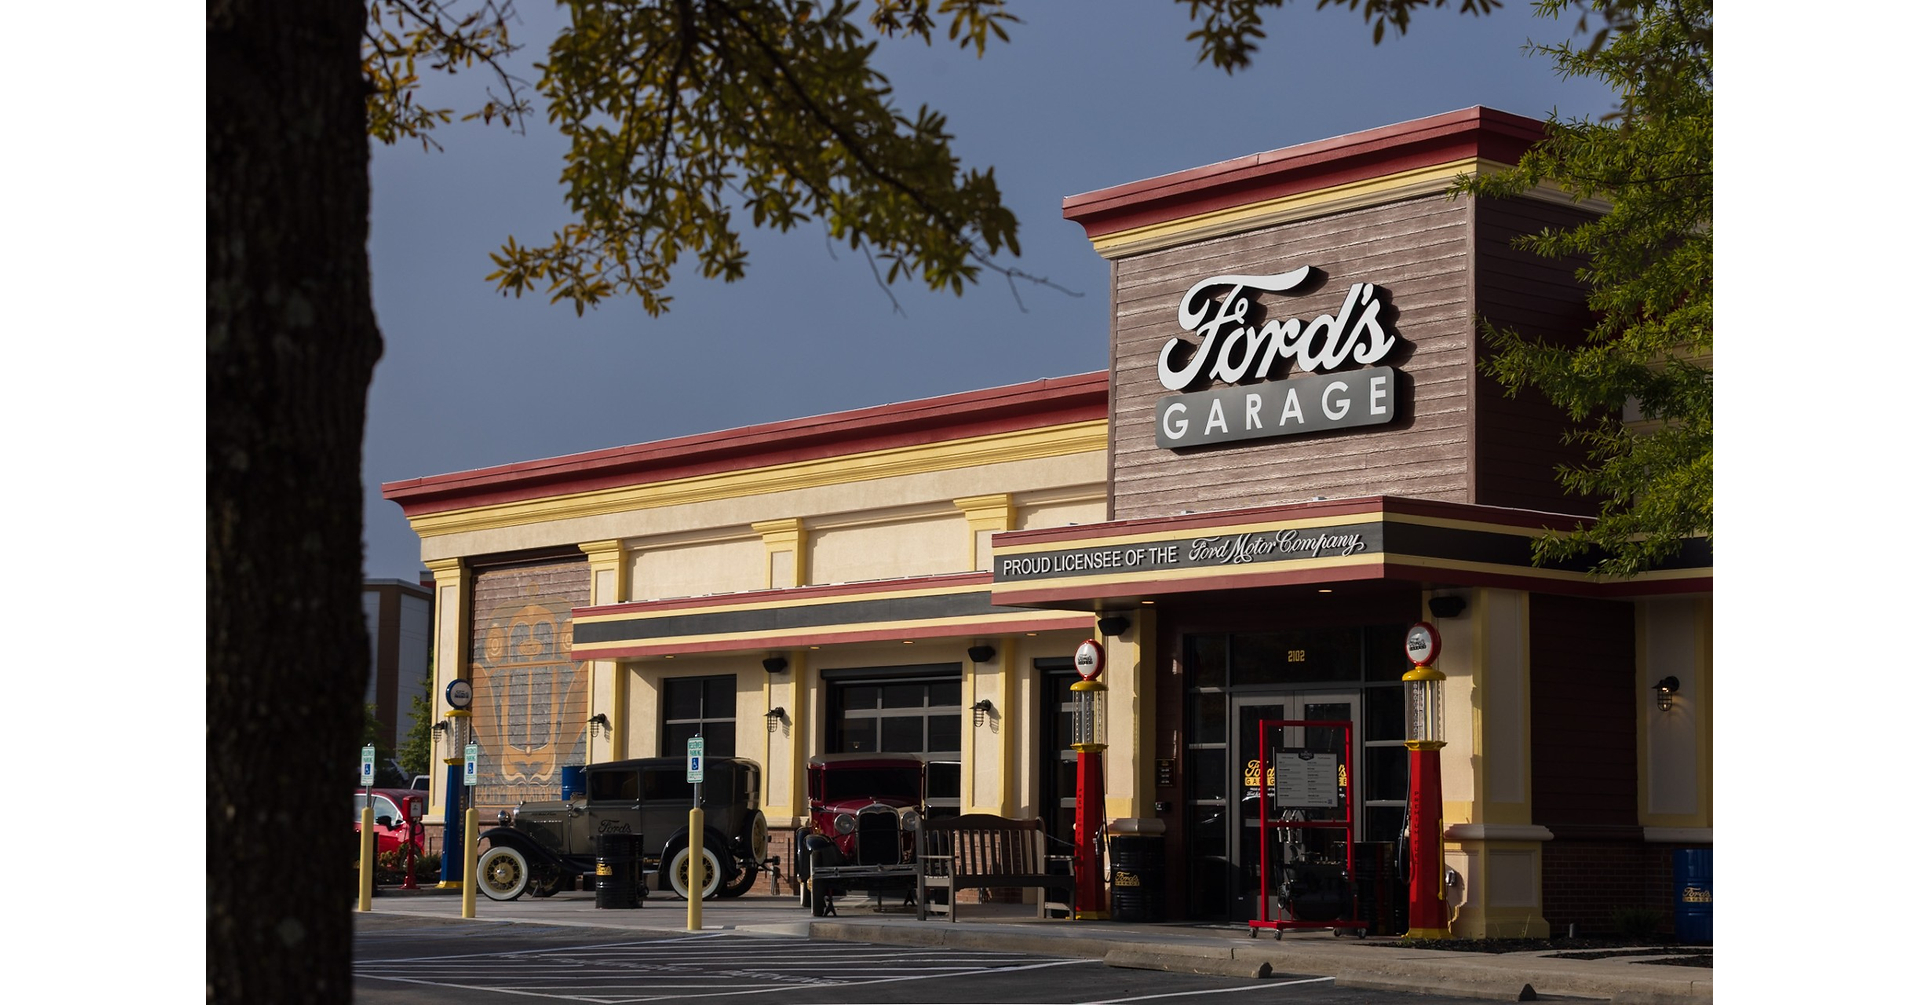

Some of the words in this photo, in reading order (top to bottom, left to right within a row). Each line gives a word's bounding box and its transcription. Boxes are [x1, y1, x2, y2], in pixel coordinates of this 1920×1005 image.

[1158, 265, 1396, 390] Ford's
[1162, 376, 1387, 440] GARAGE
[1003, 557, 1051, 575] PROUD
[1054, 551, 1121, 572] LICENSEE
[1125, 549, 1145, 566] OF
[1149, 546, 1177, 564] THE
[1189, 536, 1229, 561] Ford
[1220, 533, 1278, 564] Motor
[1276, 529, 1365, 557] Company
[1287, 650, 1305, 663] 2102
[598, 819, 632, 833] Ford's
